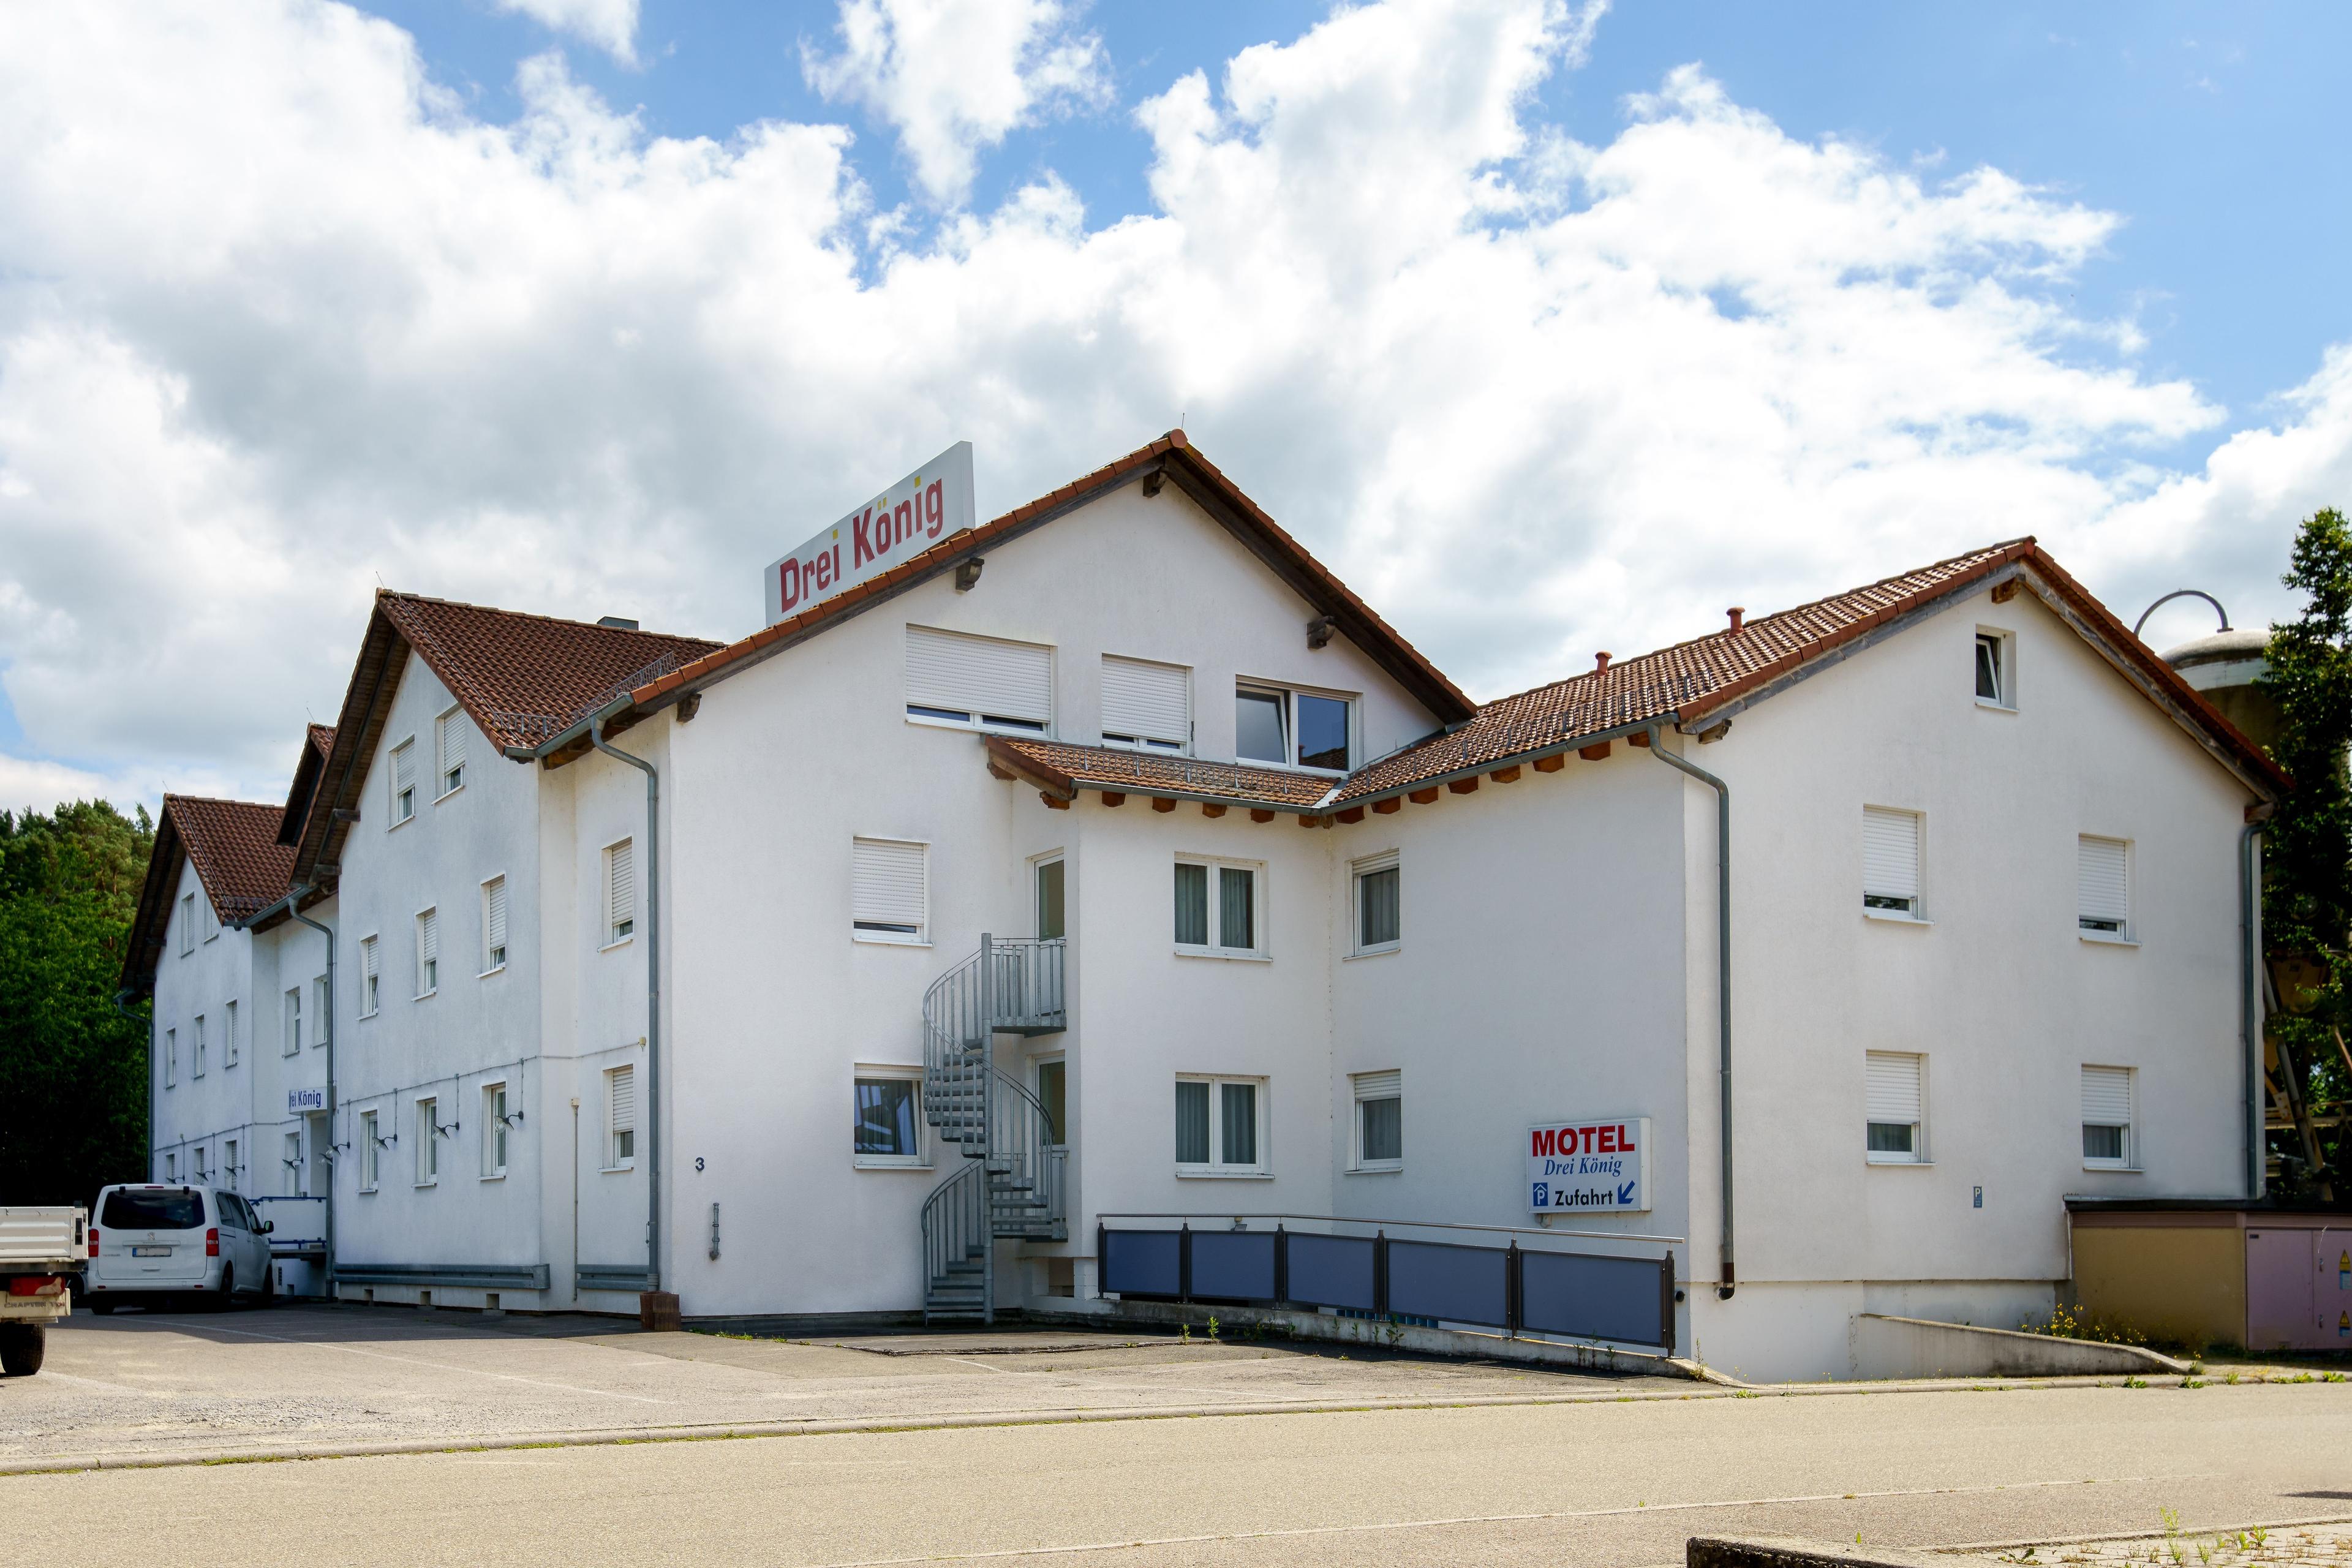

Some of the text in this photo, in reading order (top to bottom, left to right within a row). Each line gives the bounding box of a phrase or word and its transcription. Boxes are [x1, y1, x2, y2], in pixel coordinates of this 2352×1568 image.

[780, 475, 943, 614] Drei König
[298, 1090, 321, 1108] König
[1532, 1125, 1635, 1157] MOTEL
[695, 1157, 705, 1171] 3
[1544, 1156, 1623, 1177] Drei König
[1555, 1188, 1613, 1206] Zufahrt
[1975, 1188, 1981, 1197] P
